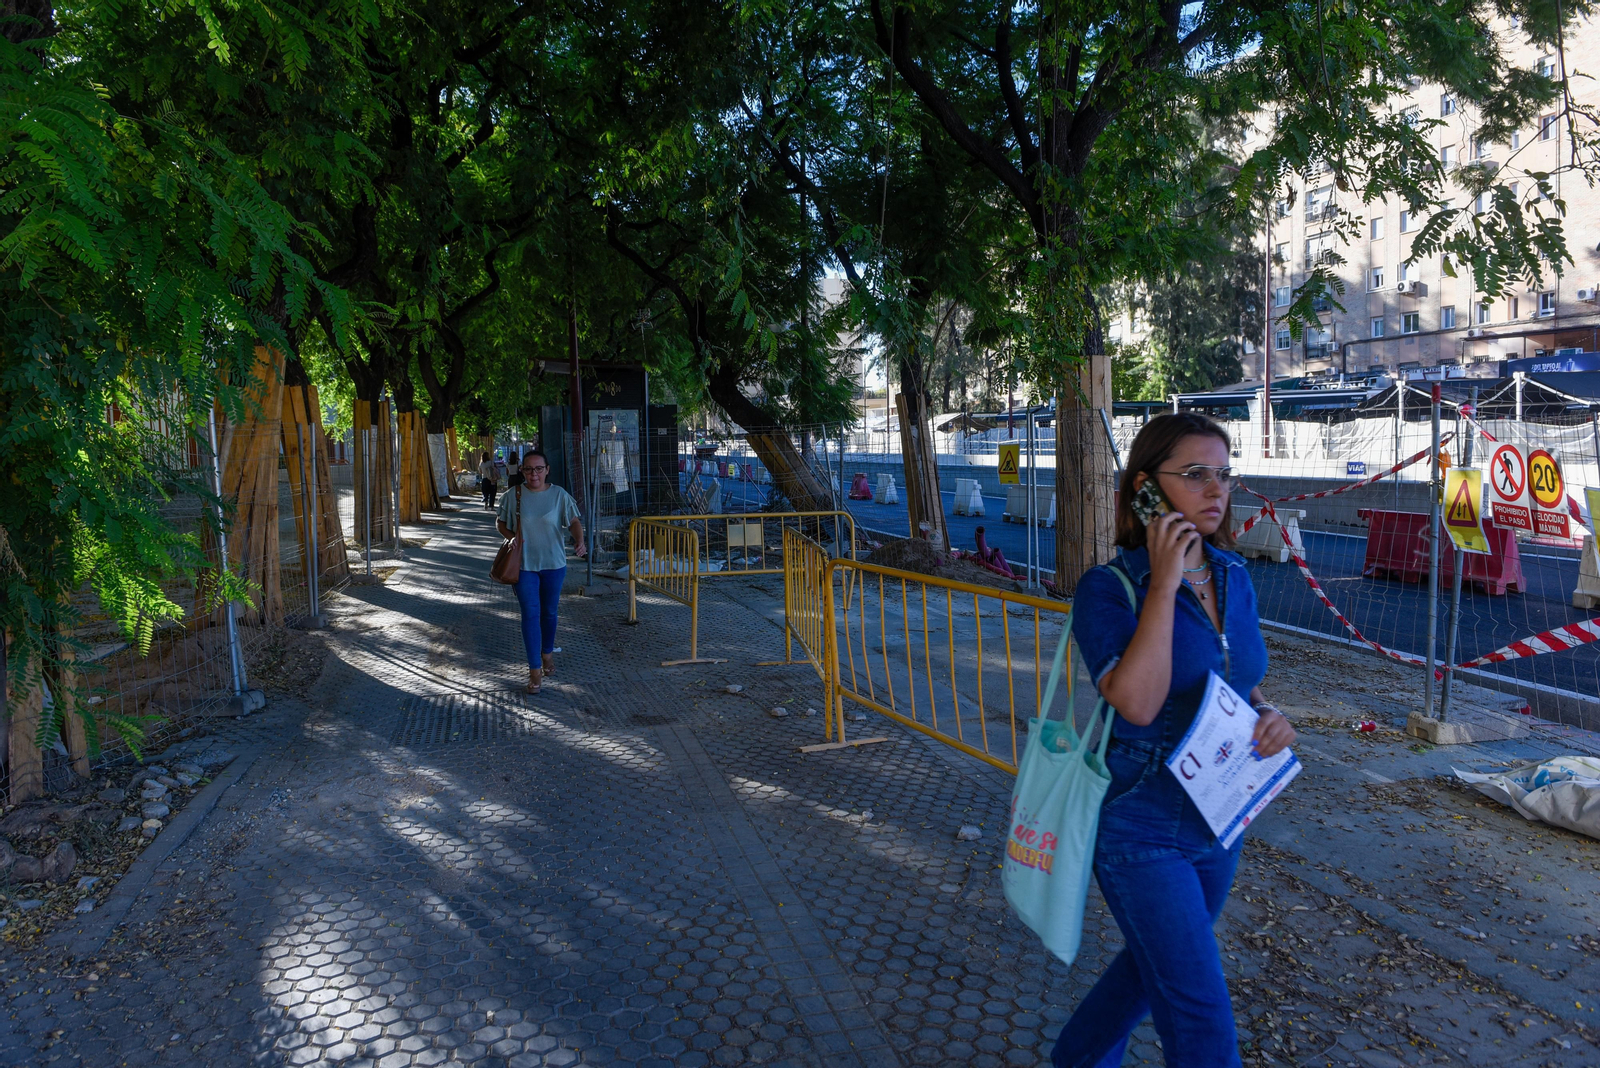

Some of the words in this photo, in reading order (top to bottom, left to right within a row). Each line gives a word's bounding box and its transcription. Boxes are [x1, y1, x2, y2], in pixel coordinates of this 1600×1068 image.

[1533, 463, 1555, 493] 20
[1494, 505, 1528, 517] PROHIBIDO
[1500, 515, 1508, 523] EL
[1508, 516, 1526, 526] PASO
[1533, 512, 1565, 525] VELOCIDAD
[1539, 522, 1562, 535] MÁXIMA
[1217, 685, 1238, 717] C2
[1179, 751, 1202, 781] C1
